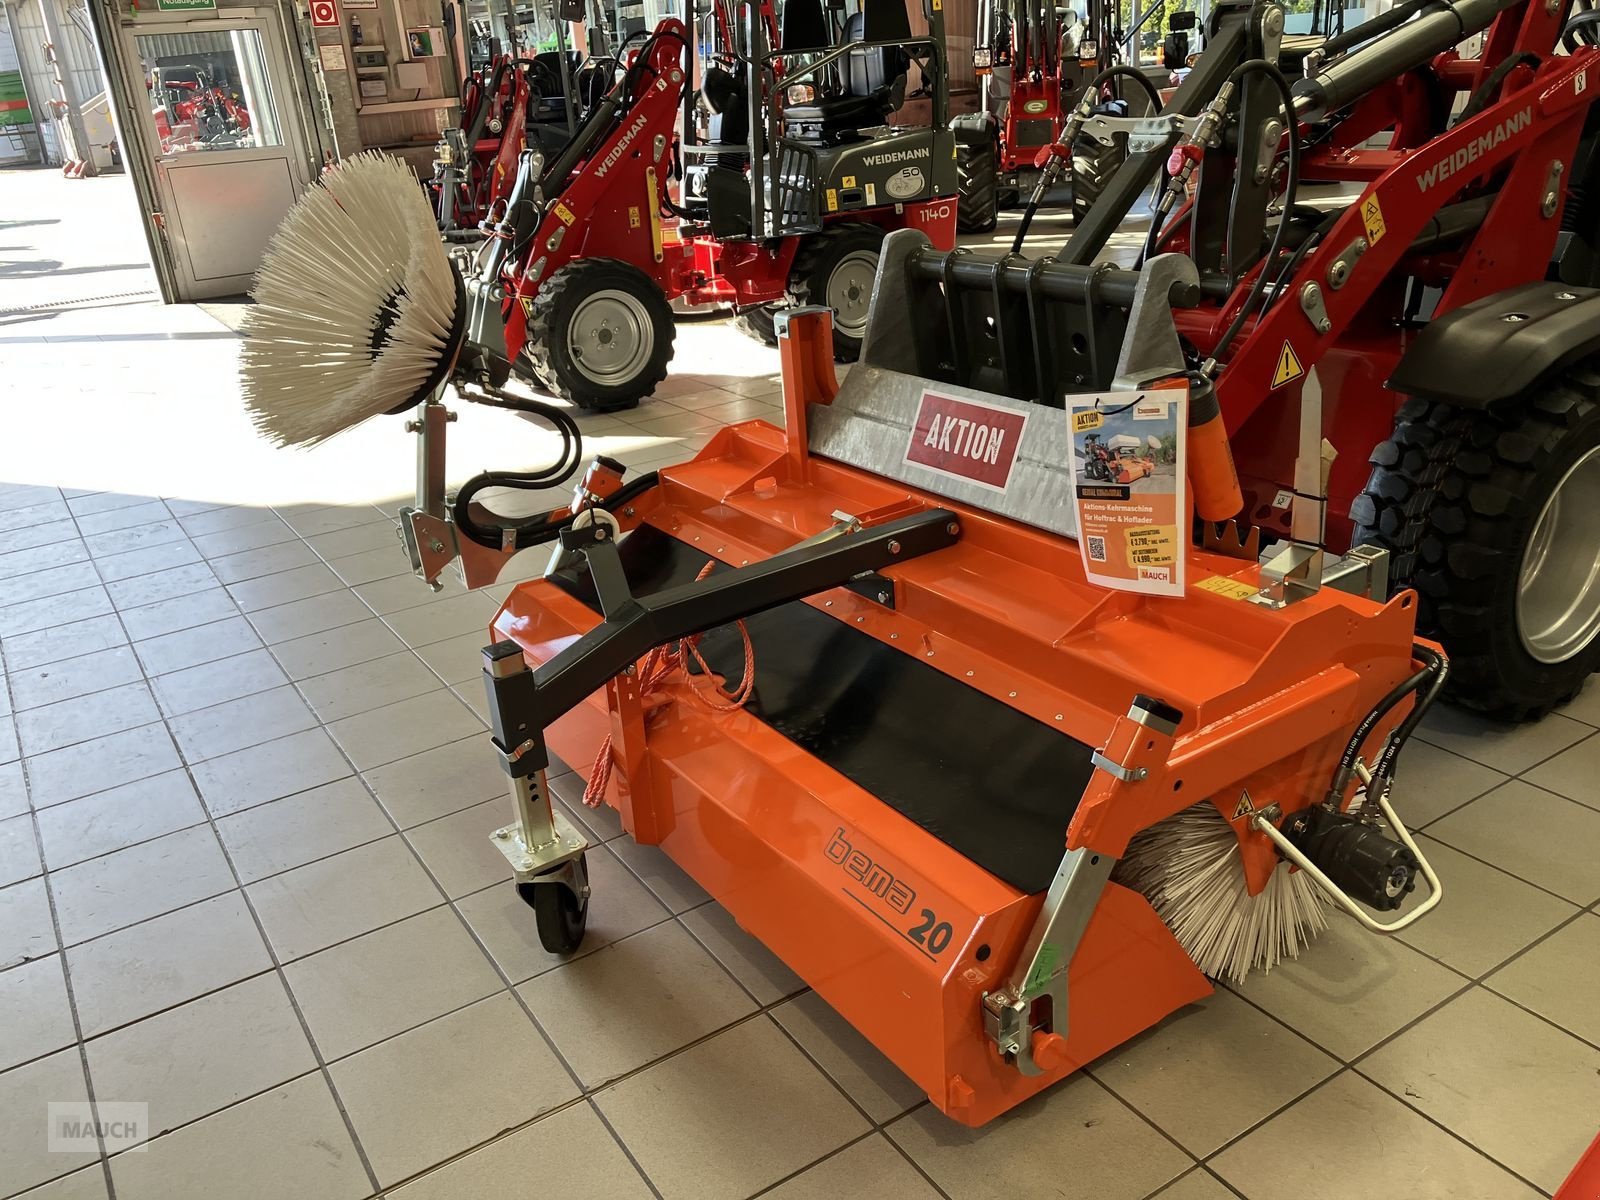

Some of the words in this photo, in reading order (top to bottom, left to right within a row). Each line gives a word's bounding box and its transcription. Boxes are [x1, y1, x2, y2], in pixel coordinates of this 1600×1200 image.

[1416, 106, 1532, 193] WEIDEMANN
[862, 148, 930, 166] WEIDEMANN
[902, 168, 920, 178] 50
[920, 206, 950, 222] 1140
[1078, 412, 1098, 425] AKTION
[924, 413, 1005, 465] AKTION
[1084, 503, 1153, 512] Aktions-Kehrmaschine
[1094, 514, 1116, 522] Hoftrac
[1142, 571, 1168, 580] MAUCH
[824, 826, 916, 915] bema
[907, 908, 953, 954] 20
